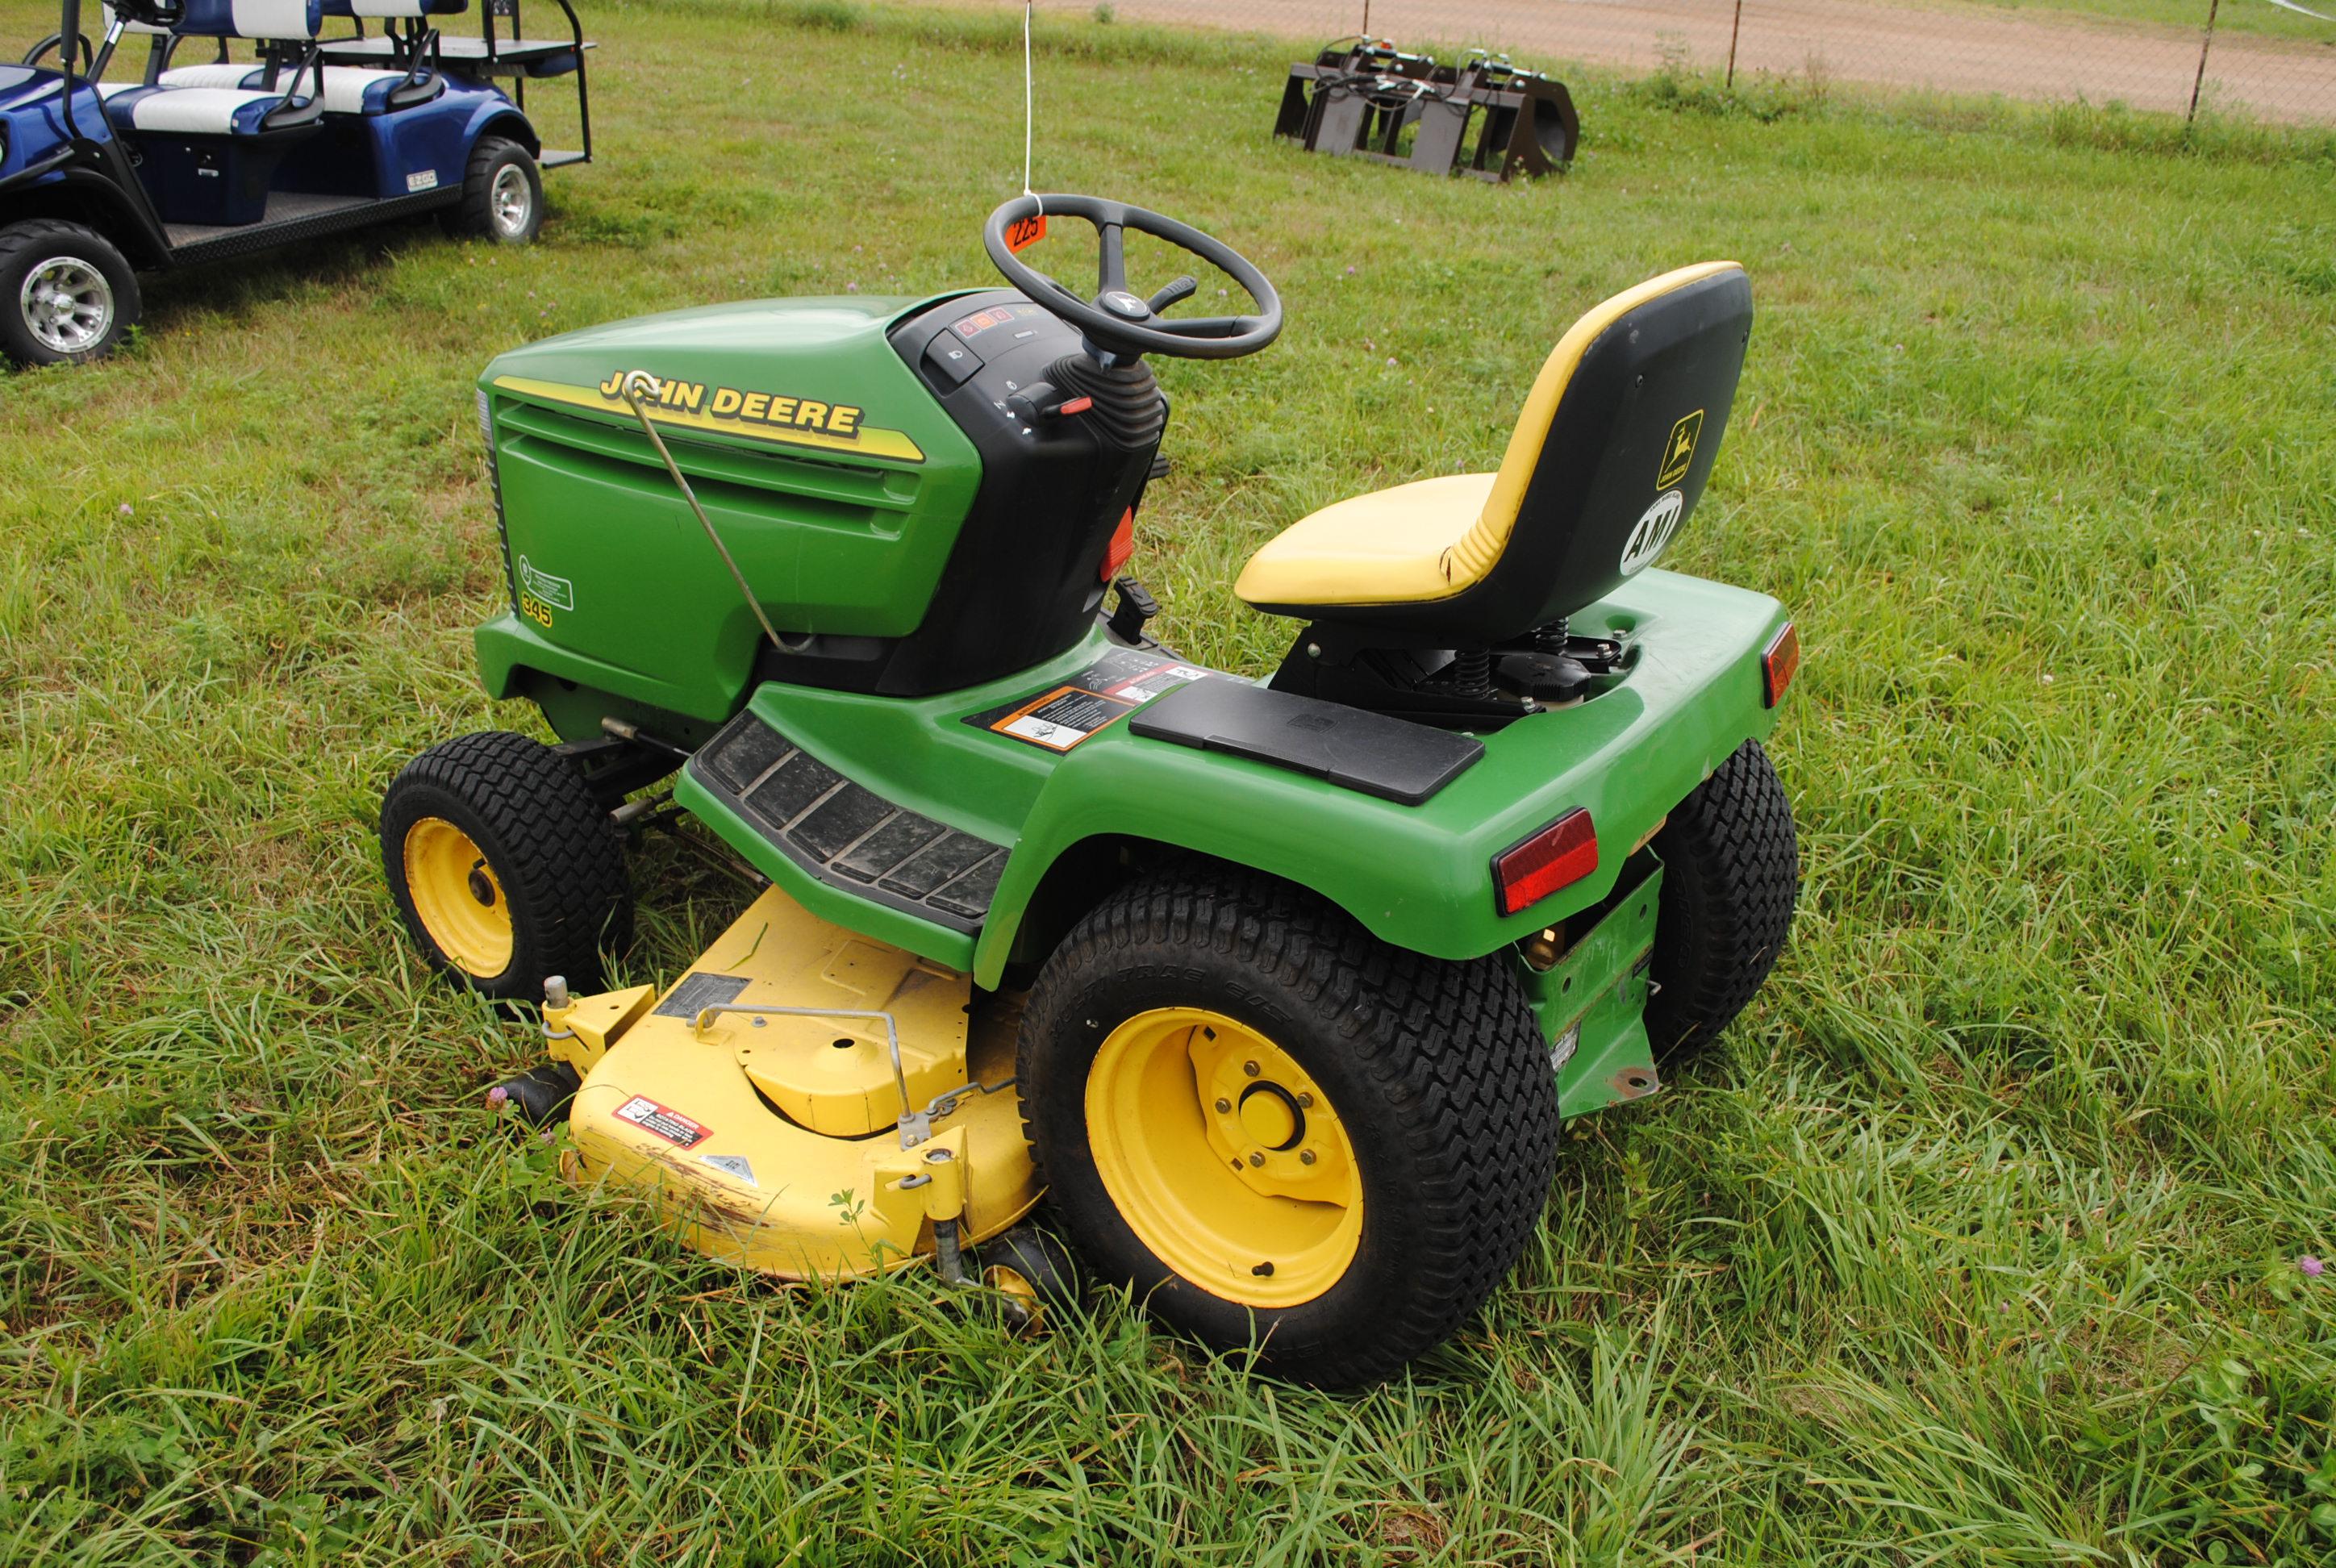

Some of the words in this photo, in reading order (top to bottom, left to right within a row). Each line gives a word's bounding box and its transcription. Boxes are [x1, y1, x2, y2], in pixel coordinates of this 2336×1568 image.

[1013, 218, 1039, 247] 225
[710, 386, 866, 440] DEERE
[1623, 504, 1679, 564] AMI
[523, 591, 552, 628] 345
[673, 1114, 700, 1129] DANGER
